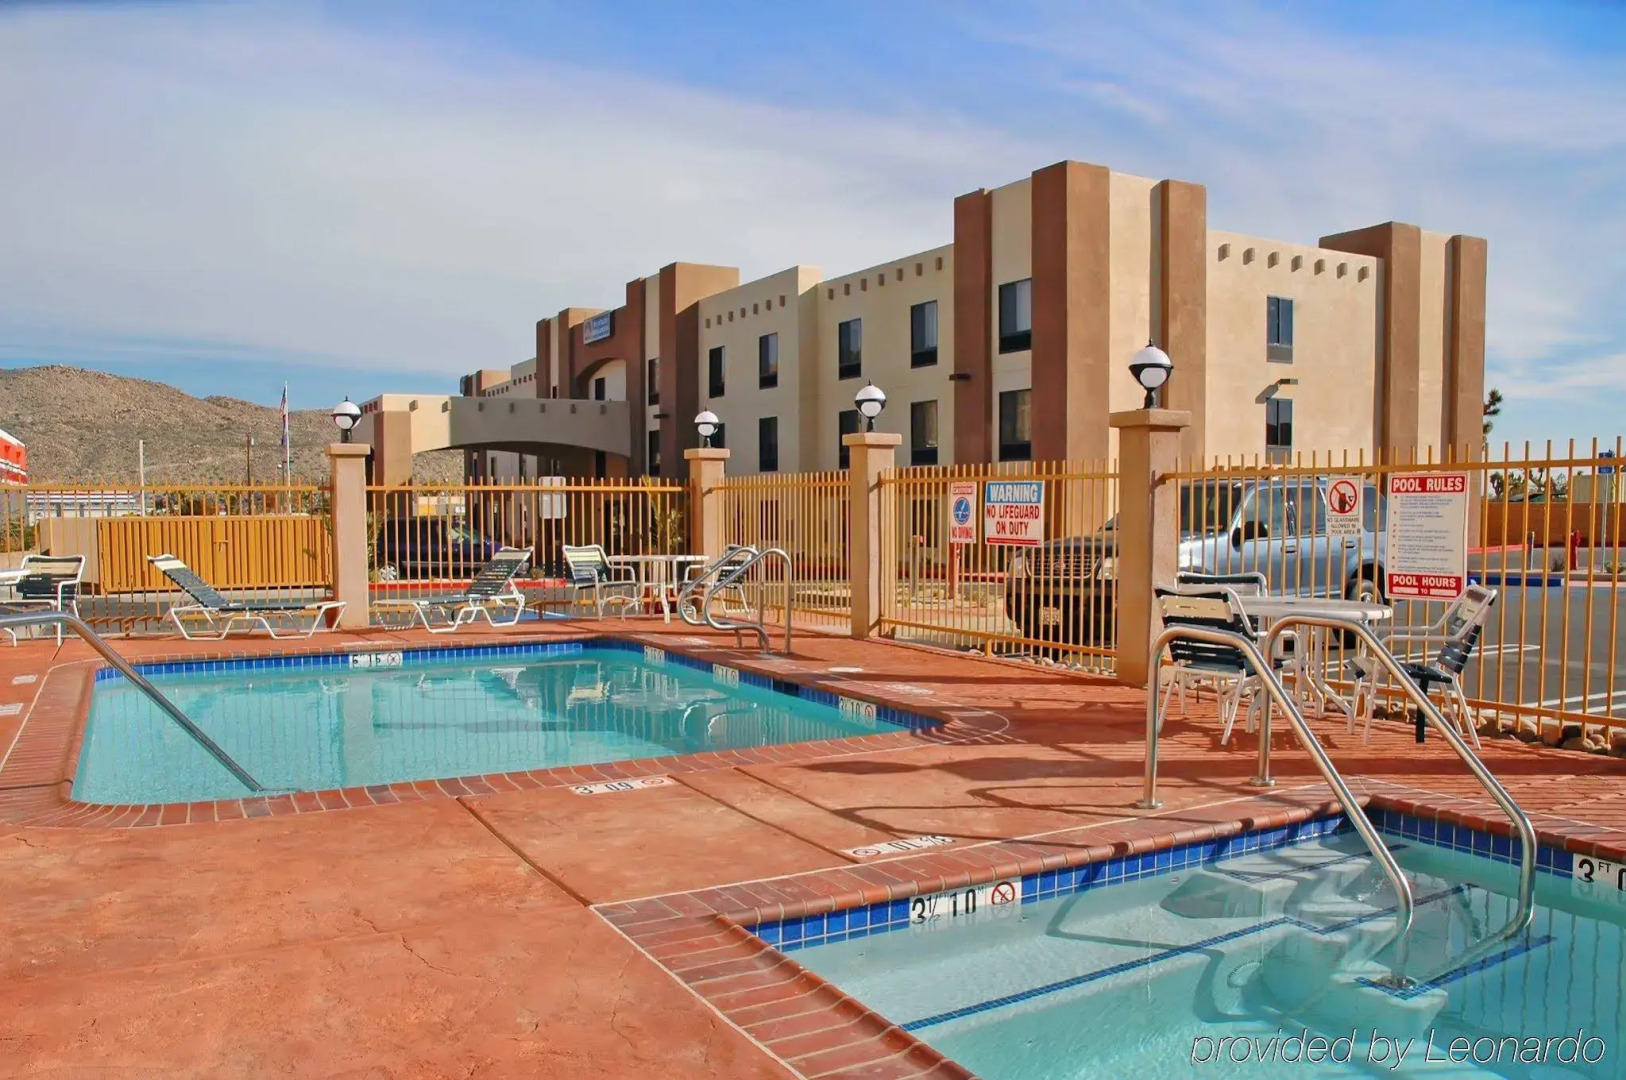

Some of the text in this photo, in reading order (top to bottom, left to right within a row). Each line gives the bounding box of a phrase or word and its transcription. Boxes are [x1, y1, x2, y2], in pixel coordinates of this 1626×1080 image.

[1393, 477, 1463, 492] POOL RULES
[990, 484, 1038, 502] WARNING
[986, 505, 1040, 519] NO LIFEGUARD
[995, 521, 1029, 536] ON DUTY
[1393, 575, 1457, 587] POOL HOURS
[1578, 858, 1595, 883] 3
[1598, 861, 1611, 873] FT
